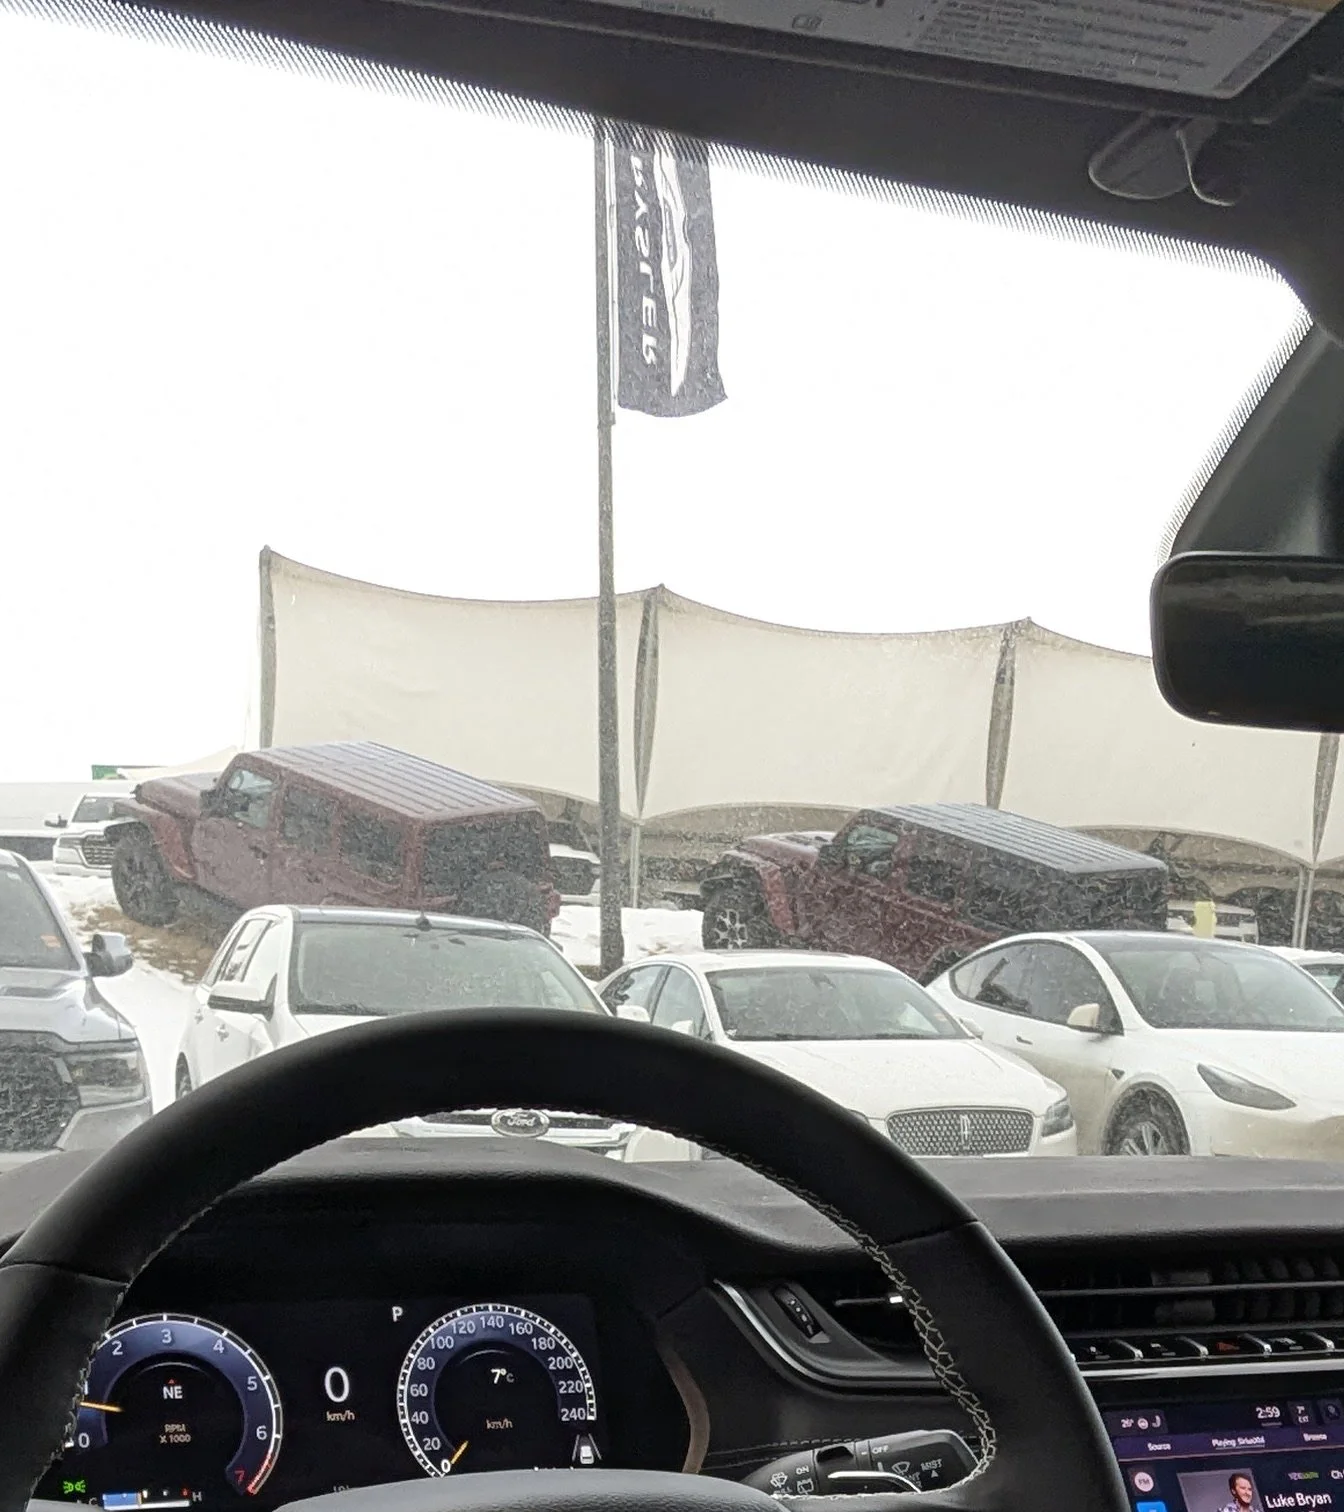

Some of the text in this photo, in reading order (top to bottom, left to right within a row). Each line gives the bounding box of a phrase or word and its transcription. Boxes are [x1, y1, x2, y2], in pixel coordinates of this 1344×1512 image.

[506, 1112, 536, 1127] Ford
[391, 1305, 404, 1323] P
[451, 1319, 477, 1335] 120
[479, 1315, 505, 1330] 140
[508, 1321, 534, 1337] 160
[160, 1328, 172, 1344] 3
[430, 1335, 455, 1350] 100
[531, 1336, 557, 1351] 180
[111, 1339, 124, 1356] 2
[212, 1338, 226, 1354] 4
[416, 1356, 436, 1371] 80
[547, 1355, 574, 1370] 200
[246, 1376, 258, 1392] 5
[323, 1366, 351, 1403] 0
[409, 1382, 429, 1397] 60
[558, 1379, 584, 1394] 220
[162, 1385, 184, 1401] NE
[325, 1409, 356, 1423] km/h
[410, 1410, 430, 1425] 40
[560, 1407, 587, 1422] 240
[1255, 1406, 1282, 1420] 2:59
[163, 1422, 187, 1434] RPM
[255, 1424, 268, 1440] 6
[485, 1418, 514, 1431] km/h
[77, 1432, 91, 1449] 0
[168, 1433, 192, 1445] 1000
[422, 1436, 442, 1452] 20
[871, 1444, 890, 1455] OFF
[440, 1458, 452, 1474] 0
[795, 1465, 810, 1476] ON
[234, 1469, 246, 1483] 7
[191, 1491, 203, 1503] H
[1264, 1492, 1332, 1509] Luke Bryan
